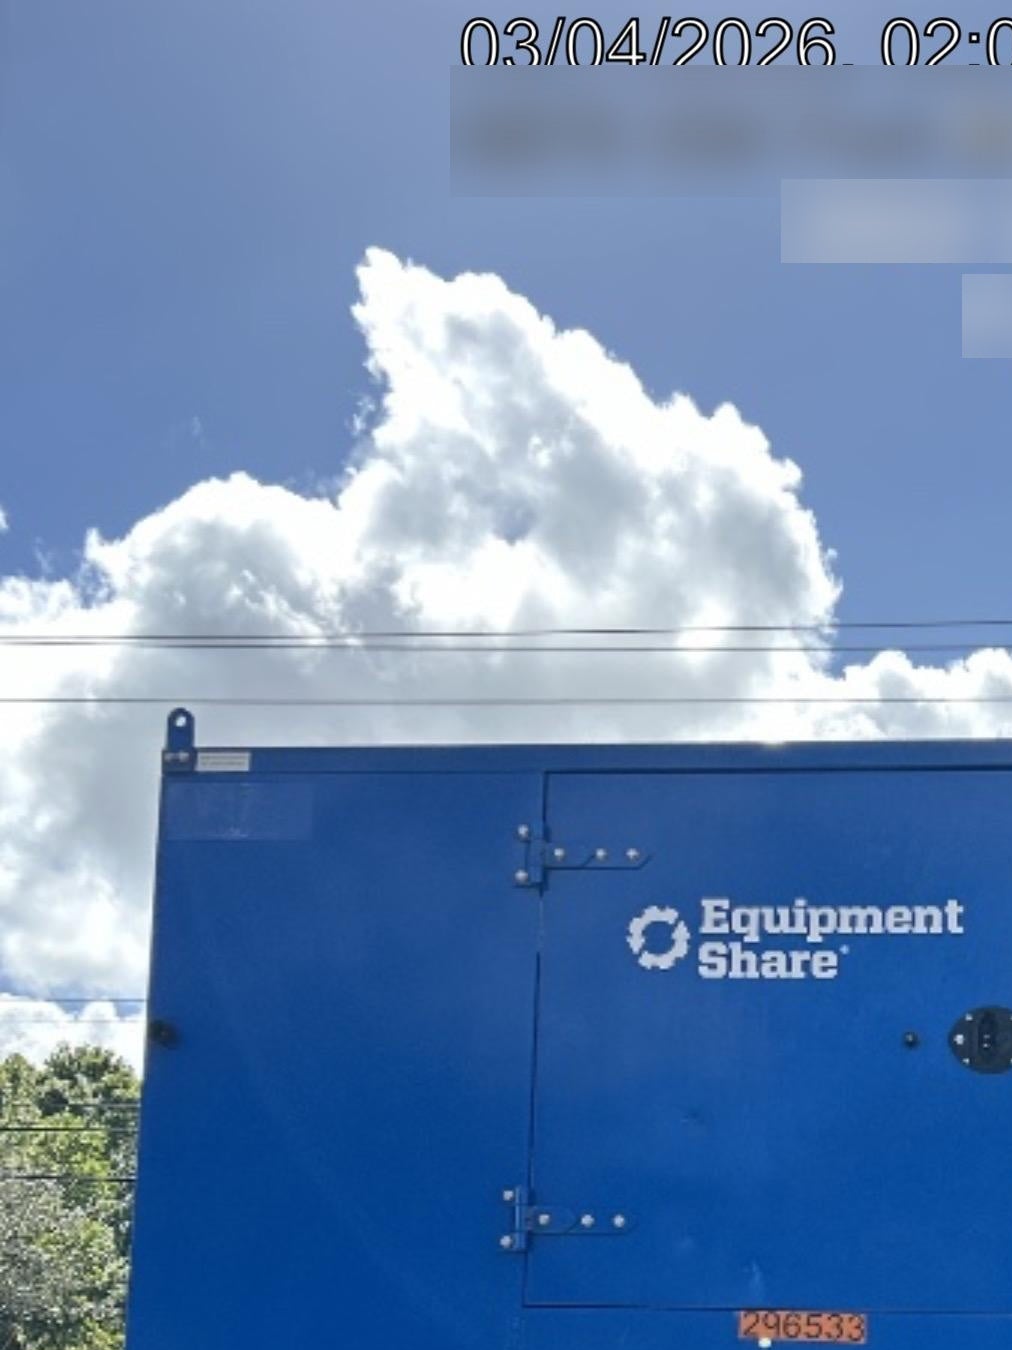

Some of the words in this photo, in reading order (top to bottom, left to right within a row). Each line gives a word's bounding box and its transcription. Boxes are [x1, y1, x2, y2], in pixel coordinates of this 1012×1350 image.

[699, 898, 964, 943] Equipment
[698, 941, 840, 979] Share
[742, 1311, 865, 1342] 296533
